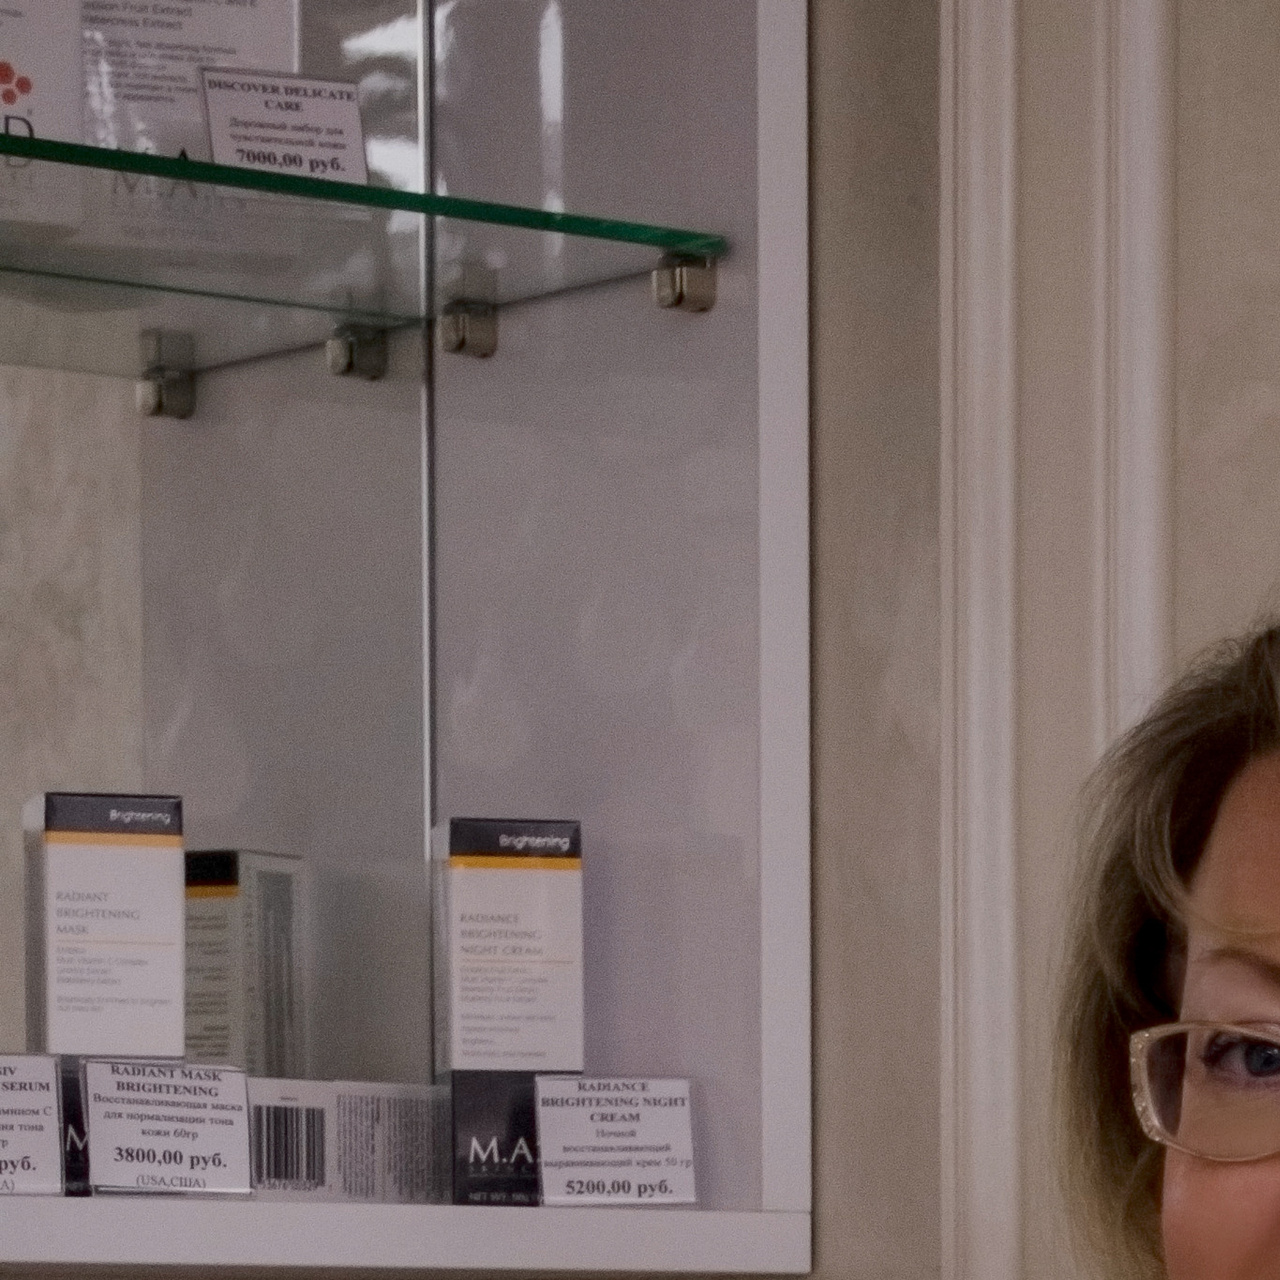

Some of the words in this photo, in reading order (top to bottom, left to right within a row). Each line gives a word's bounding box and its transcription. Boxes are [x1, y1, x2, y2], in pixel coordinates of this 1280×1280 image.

[208, 79, 280, 95] DISCOVER
[284, 86, 356, 102] DELICATE
[264, 100, 303, 112] CARE
[235, 148, 303, 169] 7000,00
[308, 157, 346, 173] руб.
[109, 808, 171, 825] Brightening
[498, 833, 571, 852] Brightening
[56, 891, 109, 902] RADIANT
[56, 907, 141, 920] BRIGHTENING
[460, 913, 519, 924] RADIANCE
[110, 1065, 176, 1080] RADIANT
[181, 1069, 222, 1082] MASK
[2, 1081, 50, 1092] SERUM
[115, 1081, 219, 1098] BRIGHTENING
[577, 1082, 650, 1092] RADIANCE
[93, 1093, 208, 1110] Восстанавливающая
[211, 1102, 244, 1112] маска
[541, 1096, 640, 1108] BRIGHTENING
[642, 1096, 688, 1107] NIGHT
[103, 1111, 124, 1120] для
[126, 1112, 206, 1125] нормализации
[209, 1117, 234, 1126] тона
[589, 1112, 641, 1123] CREAM
[18, 1124, 44, 1132] тона
[141, 1129, 171, 1138] кожи
[173, 1128, 199, 1142] 60гр
[595, 1128, 637, 1138] Ночной
[0, 1155, 37, 1175] руб.
[113, 1147, 184, 1167] 3800,00
[189, 1152, 227, 1170] руб.
[136, 1175, 207, 1190] (USA,США)
[565, 1179, 632, 1196] 5200,00
[636, 1179, 674, 1198] руб.
